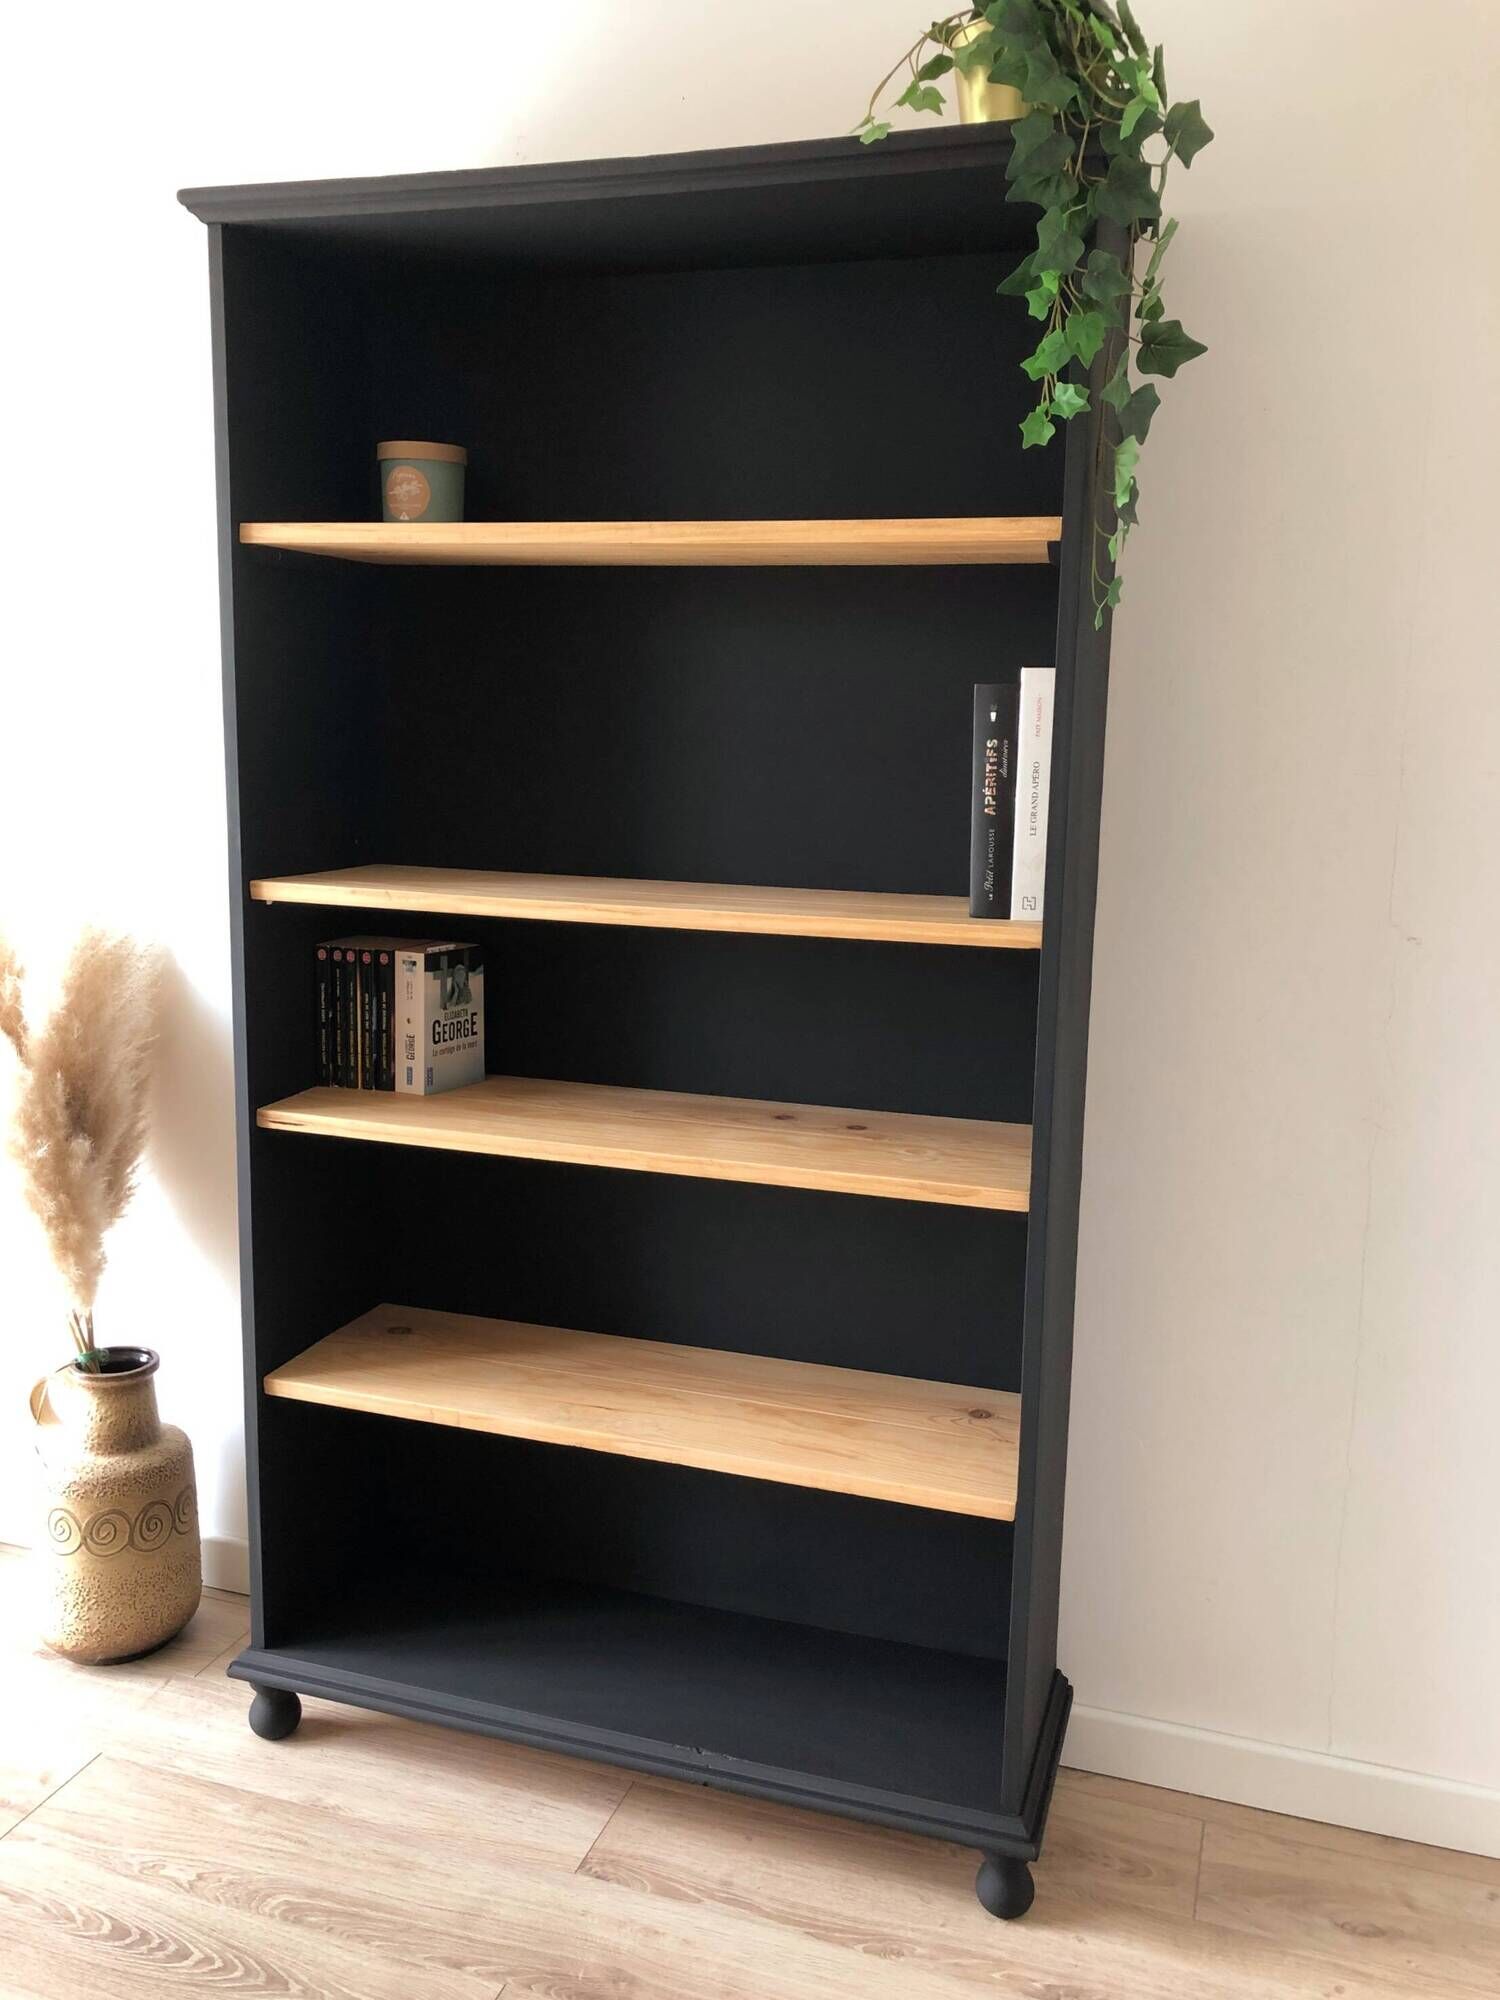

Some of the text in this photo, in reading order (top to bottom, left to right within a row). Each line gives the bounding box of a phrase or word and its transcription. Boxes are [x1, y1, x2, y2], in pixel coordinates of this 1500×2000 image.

[1030, 792, 1039, 823] GRAND
[1029, 824, 1037, 836] LE
[432, 1012, 478, 1045] GEORGE
